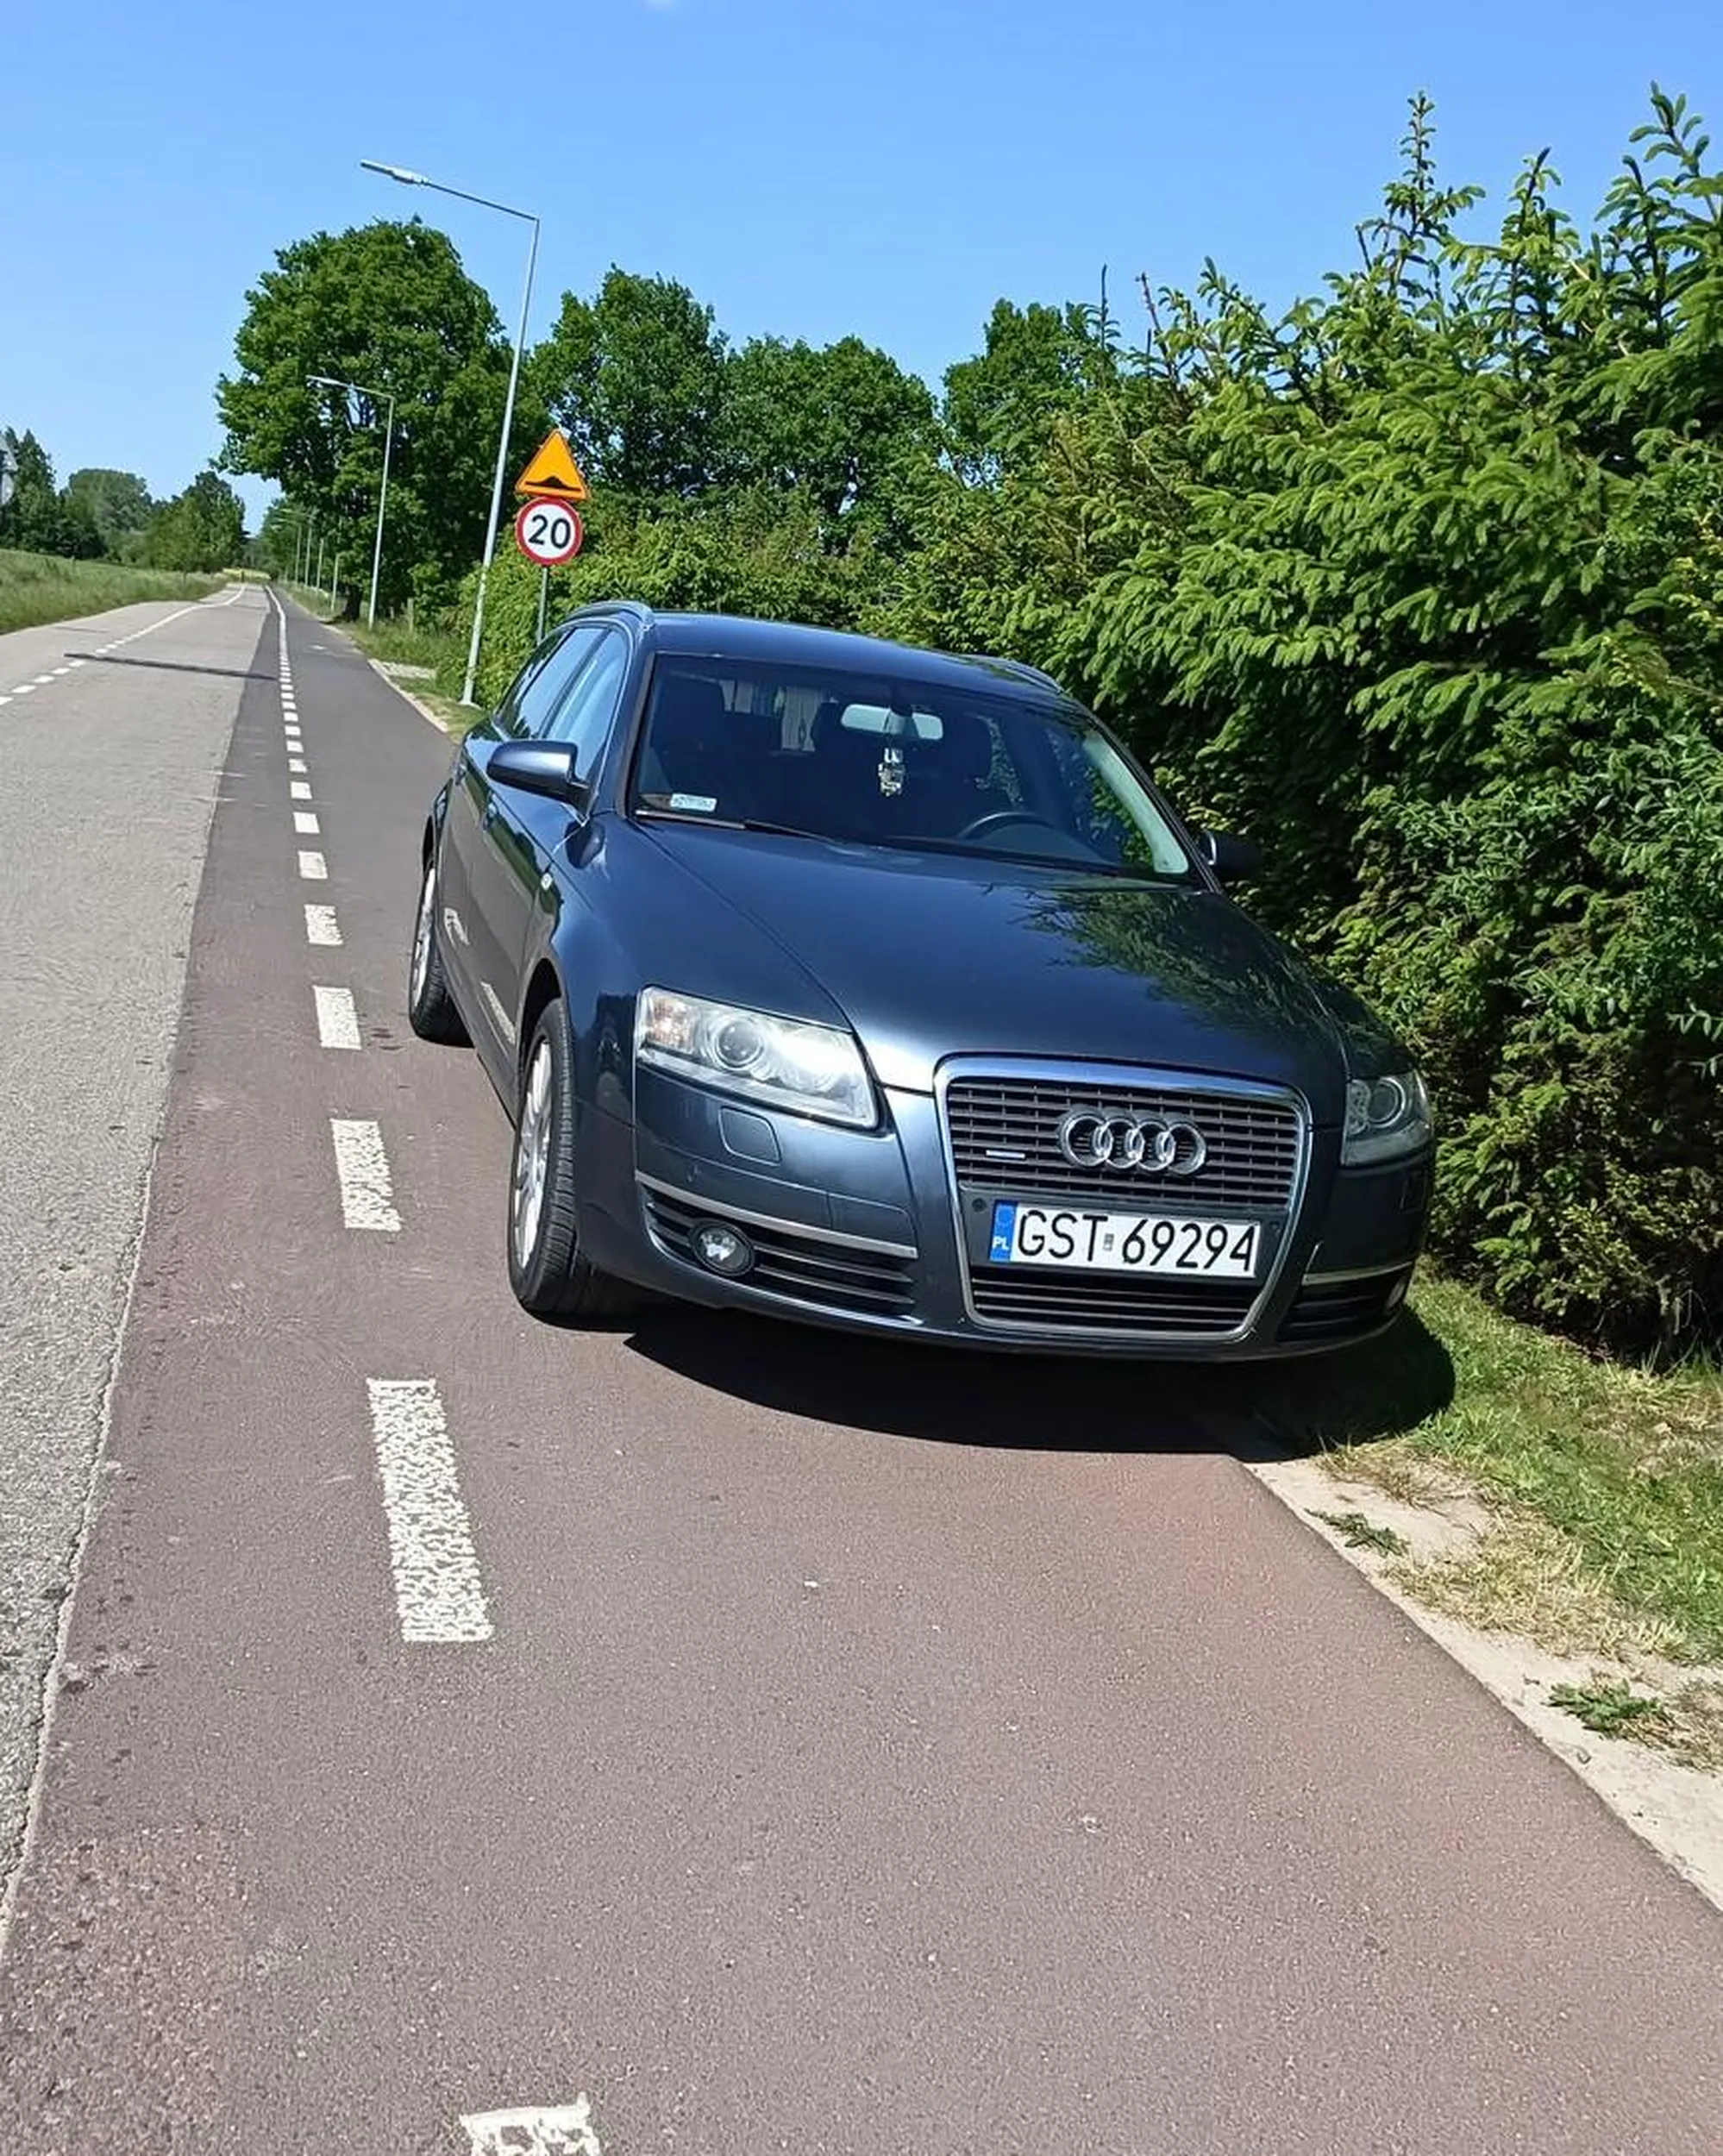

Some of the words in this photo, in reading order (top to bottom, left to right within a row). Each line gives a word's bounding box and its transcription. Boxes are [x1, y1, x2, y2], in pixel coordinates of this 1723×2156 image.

[529, 515, 571, 548] 20
[993, 1236, 1009, 1250] PL
[1018, 1210, 1108, 1262] GST
[1122, 1219, 1256, 1271] 69294
